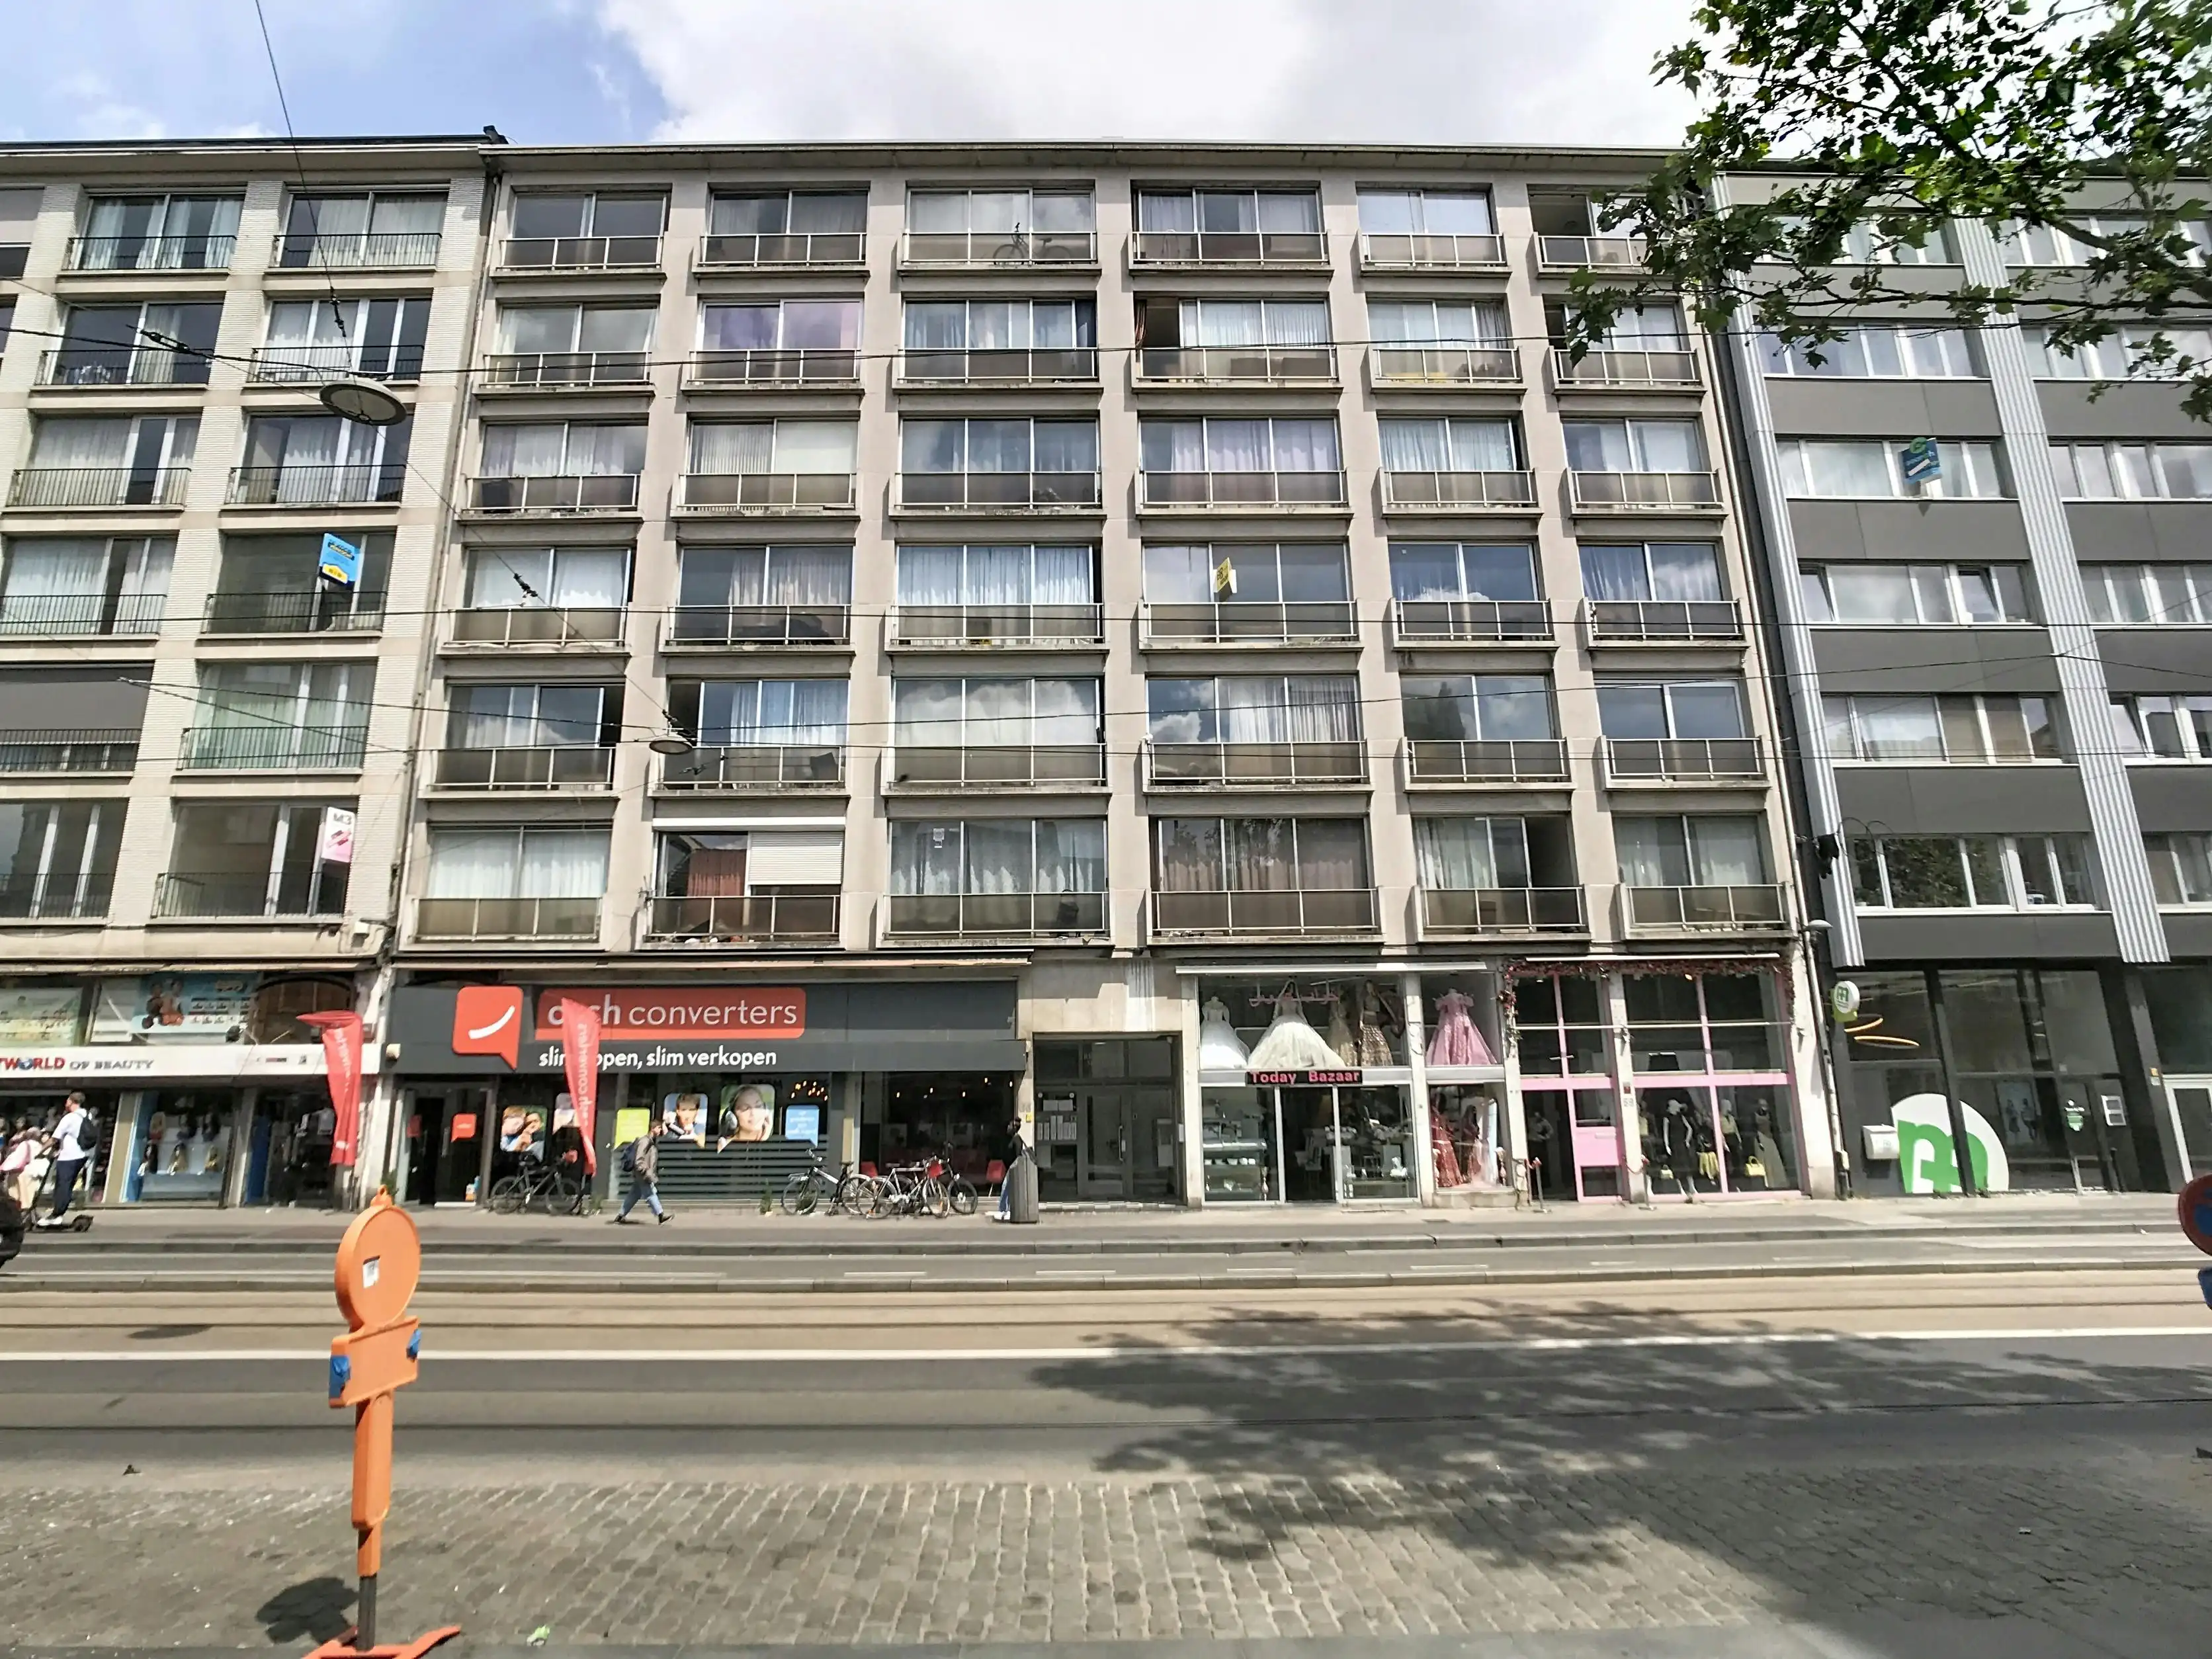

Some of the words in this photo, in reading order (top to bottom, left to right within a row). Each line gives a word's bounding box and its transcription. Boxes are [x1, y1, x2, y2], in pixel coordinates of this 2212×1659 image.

[548, 994, 620, 1025] ch
[629, 1000, 797, 1025] converters
[69, 1060, 90, 1070] OF
[94, 1060, 154, 1070] BEAUTY
[646, 1045, 683, 1067] slim
[688, 1045, 777, 1070] verkopen
[1250, 1070, 1297, 1085] Today
[1308, 1070, 1361, 1083] Bazaar
